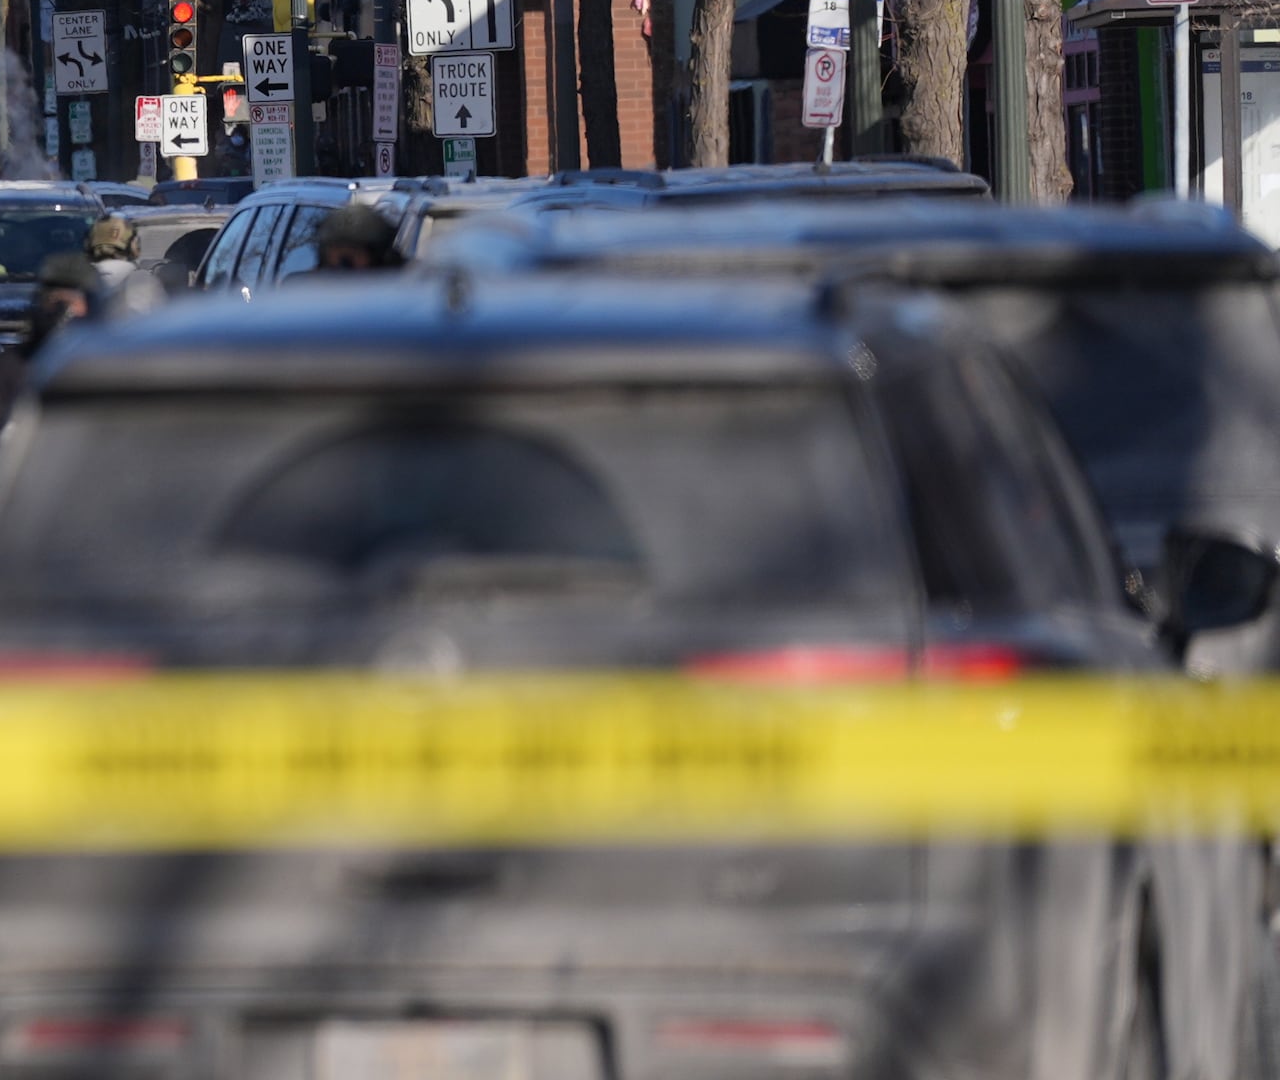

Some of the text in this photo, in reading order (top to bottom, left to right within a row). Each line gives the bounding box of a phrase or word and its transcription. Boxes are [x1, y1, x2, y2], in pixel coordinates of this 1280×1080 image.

[824, 1, 837, 11] 18
[59, 15, 98, 25] CENTER
[65, 26, 93, 36] LANE
[415, 30, 456, 47] ONLY
[253, 40, 287, 56] ONE
[252, 58, 288, 74] WAY
[439, 62, 487, 80] TRUCK
[67, 80, 96, 89] ONLY
[439, 82, 487, 98] ROUTE
[169, 101, 198, 113] ONE
[168, 116, 199, 129] WAY
